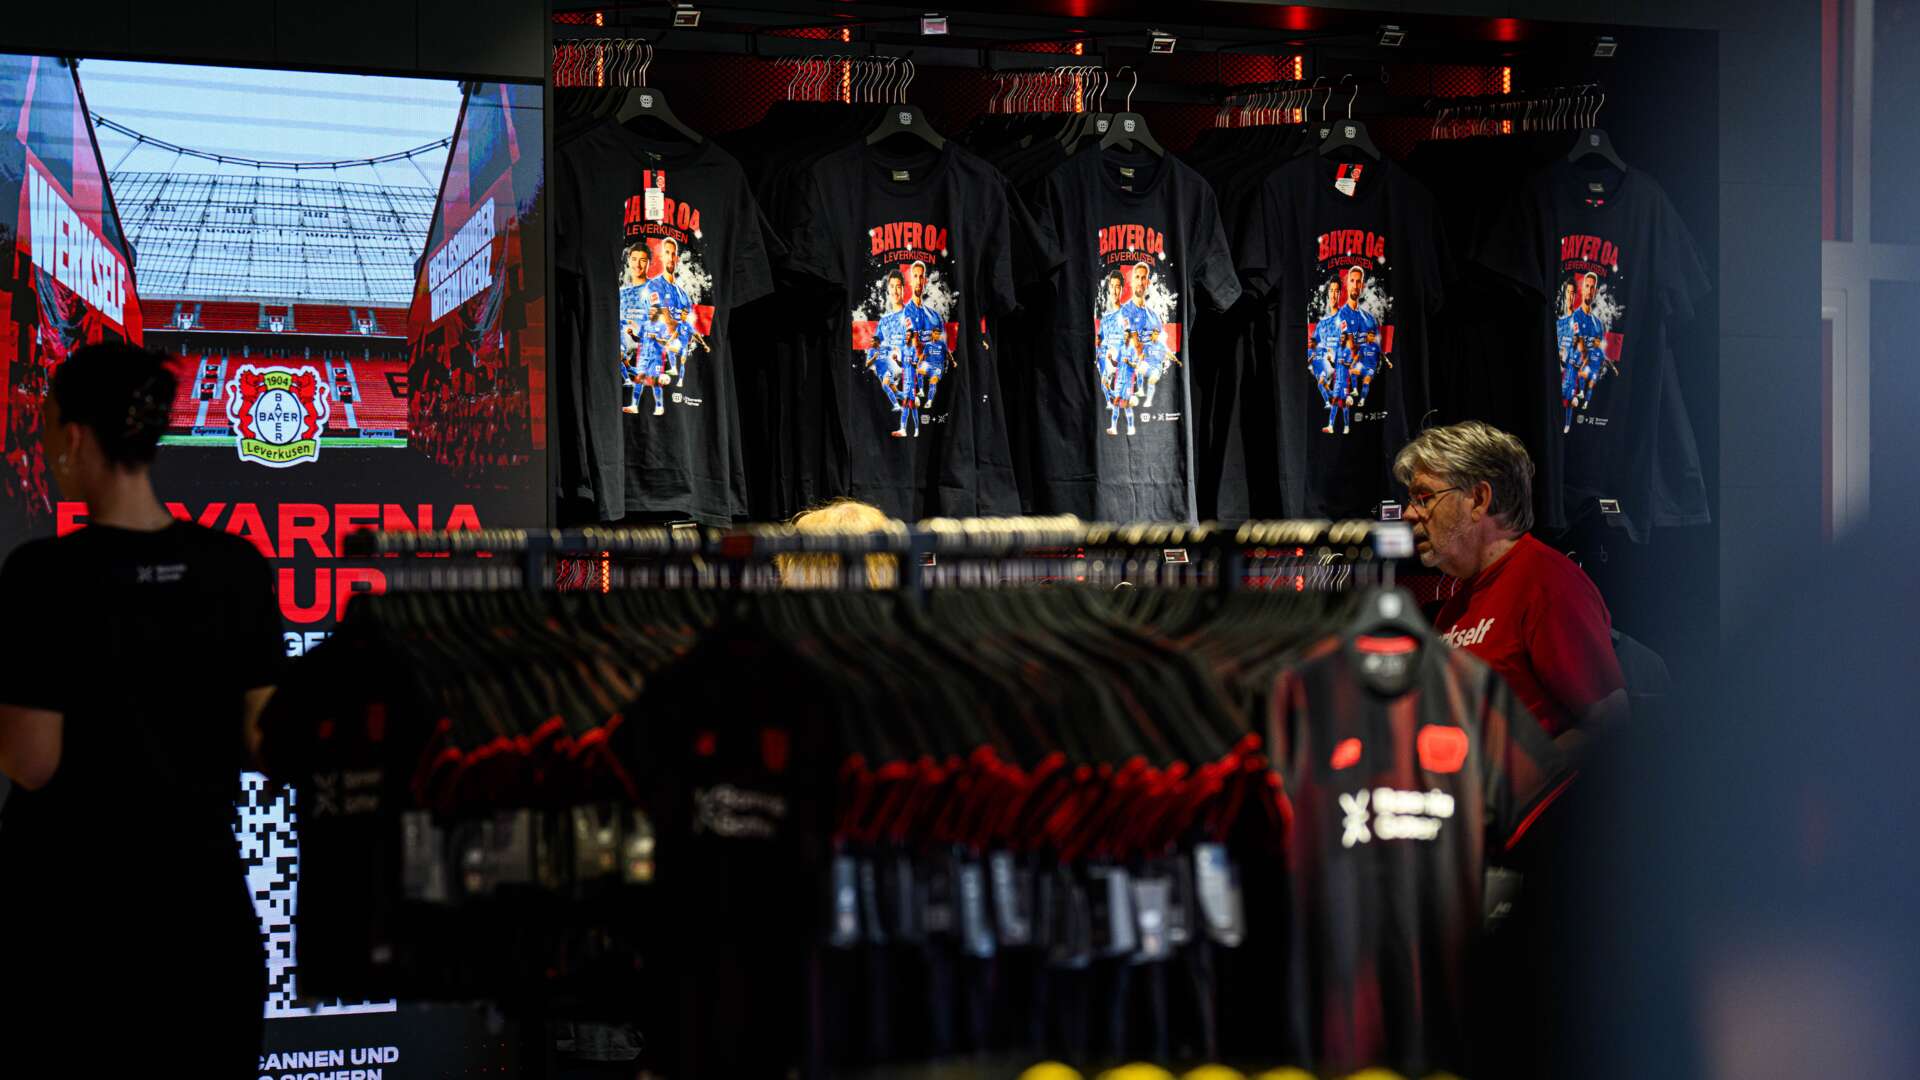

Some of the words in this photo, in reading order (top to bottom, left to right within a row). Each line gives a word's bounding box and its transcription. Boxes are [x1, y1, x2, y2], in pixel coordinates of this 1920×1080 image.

[623, 195, 676, 228] BAR
[677, 202, 701, 232] 04
[29, 163, 126, 326] WERKSELF
[626, 223, 689, 244] LEVERKUSEN
[871, 221, 923, 257] BAYER
[924, 224, 947, 251] 04
[1099, 224, 1145, 257] BAYER
[1146, 227, 1164, 254] 04
[1318, 229, 1364, 263] BAYER
[1365, 231, 1385, 259] 04
[884, 250, 936, 265] LEVERKUSEN
[1107, 250, 1156, 268] LEVERKUSEN
[1561, 234, 1601, 262] BAYER
[1601, 240, 1619, 266] 04
[267, 376, 288, 387] 1904
[259, 412, 298, 422] BAYER
[274, 393, 283, 441] BAYER
[247, 442, 311, 460] Leverkusen
[57, 501, 494, 558] YARENA
[276, 568, 388, 624] UP
[282, 631, 337, 658] GE
[1438, 617, 1496, 649] rkself
[350, 1046, 400, 1065] UND
